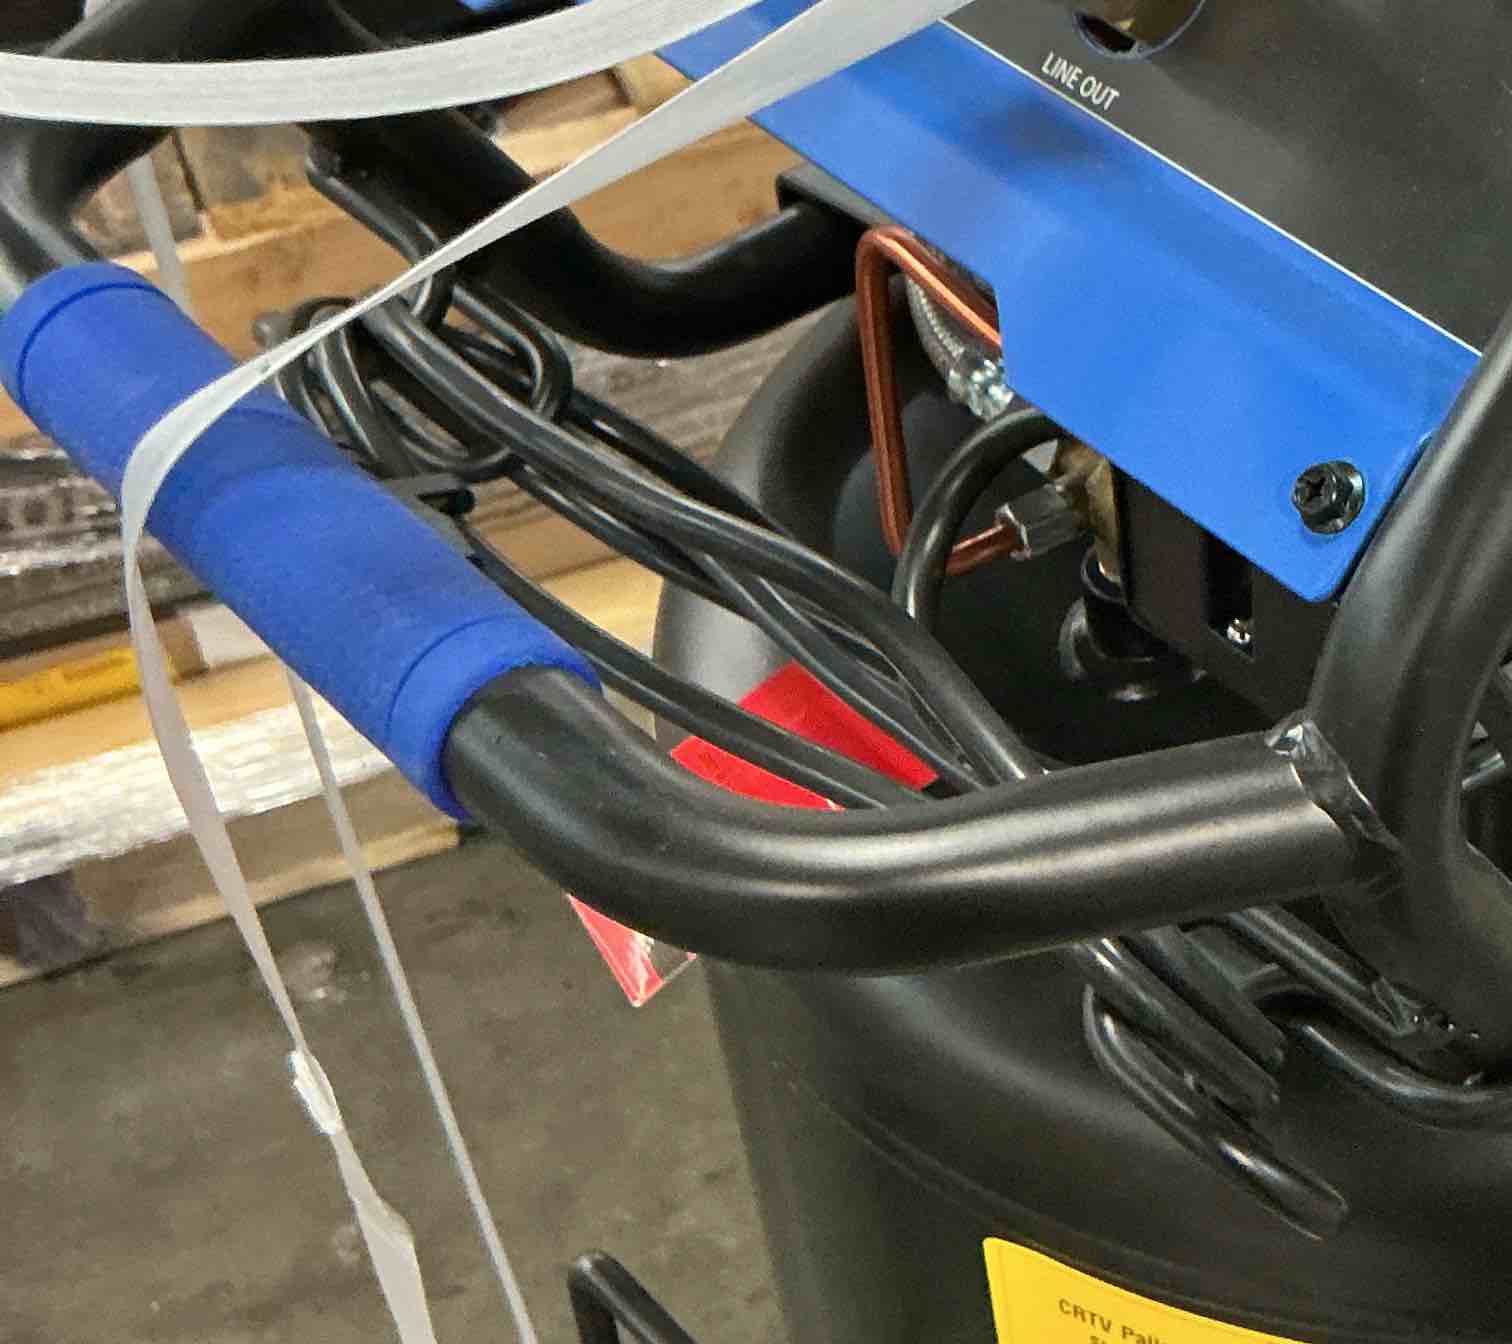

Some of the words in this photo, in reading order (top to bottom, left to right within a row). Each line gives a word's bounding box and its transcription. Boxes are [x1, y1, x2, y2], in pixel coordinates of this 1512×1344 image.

[1041, 50, 1083, 90] LINE
[1080, 76, 1120, 110] OUT
[1058, 1298, 1112, 1333] CRTV
